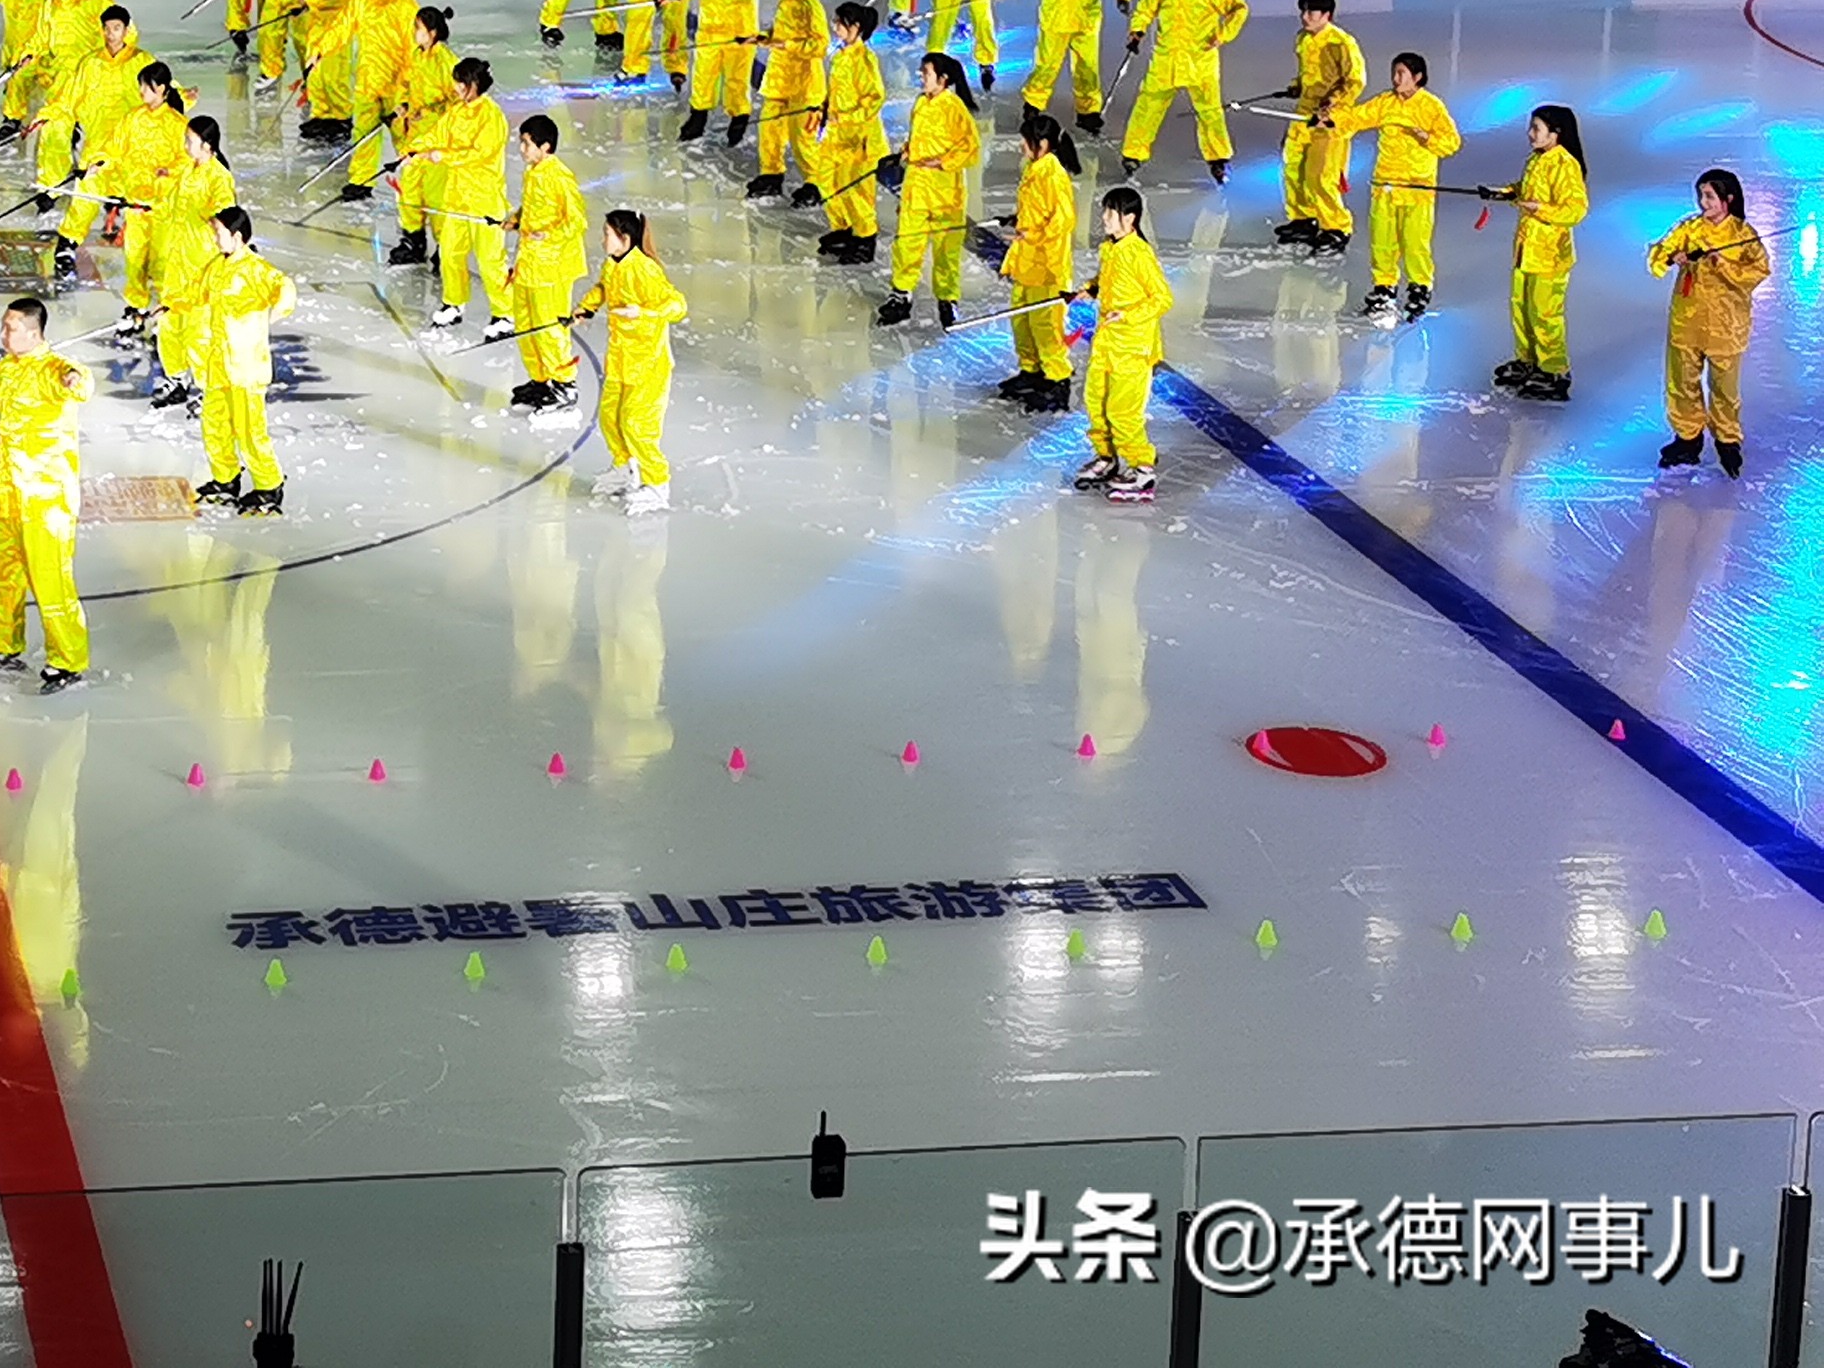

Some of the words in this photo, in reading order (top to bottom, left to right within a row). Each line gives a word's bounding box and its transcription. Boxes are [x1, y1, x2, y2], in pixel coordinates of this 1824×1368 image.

[226, 872, 1209, 950] 承德避暑山庄旅游集团
